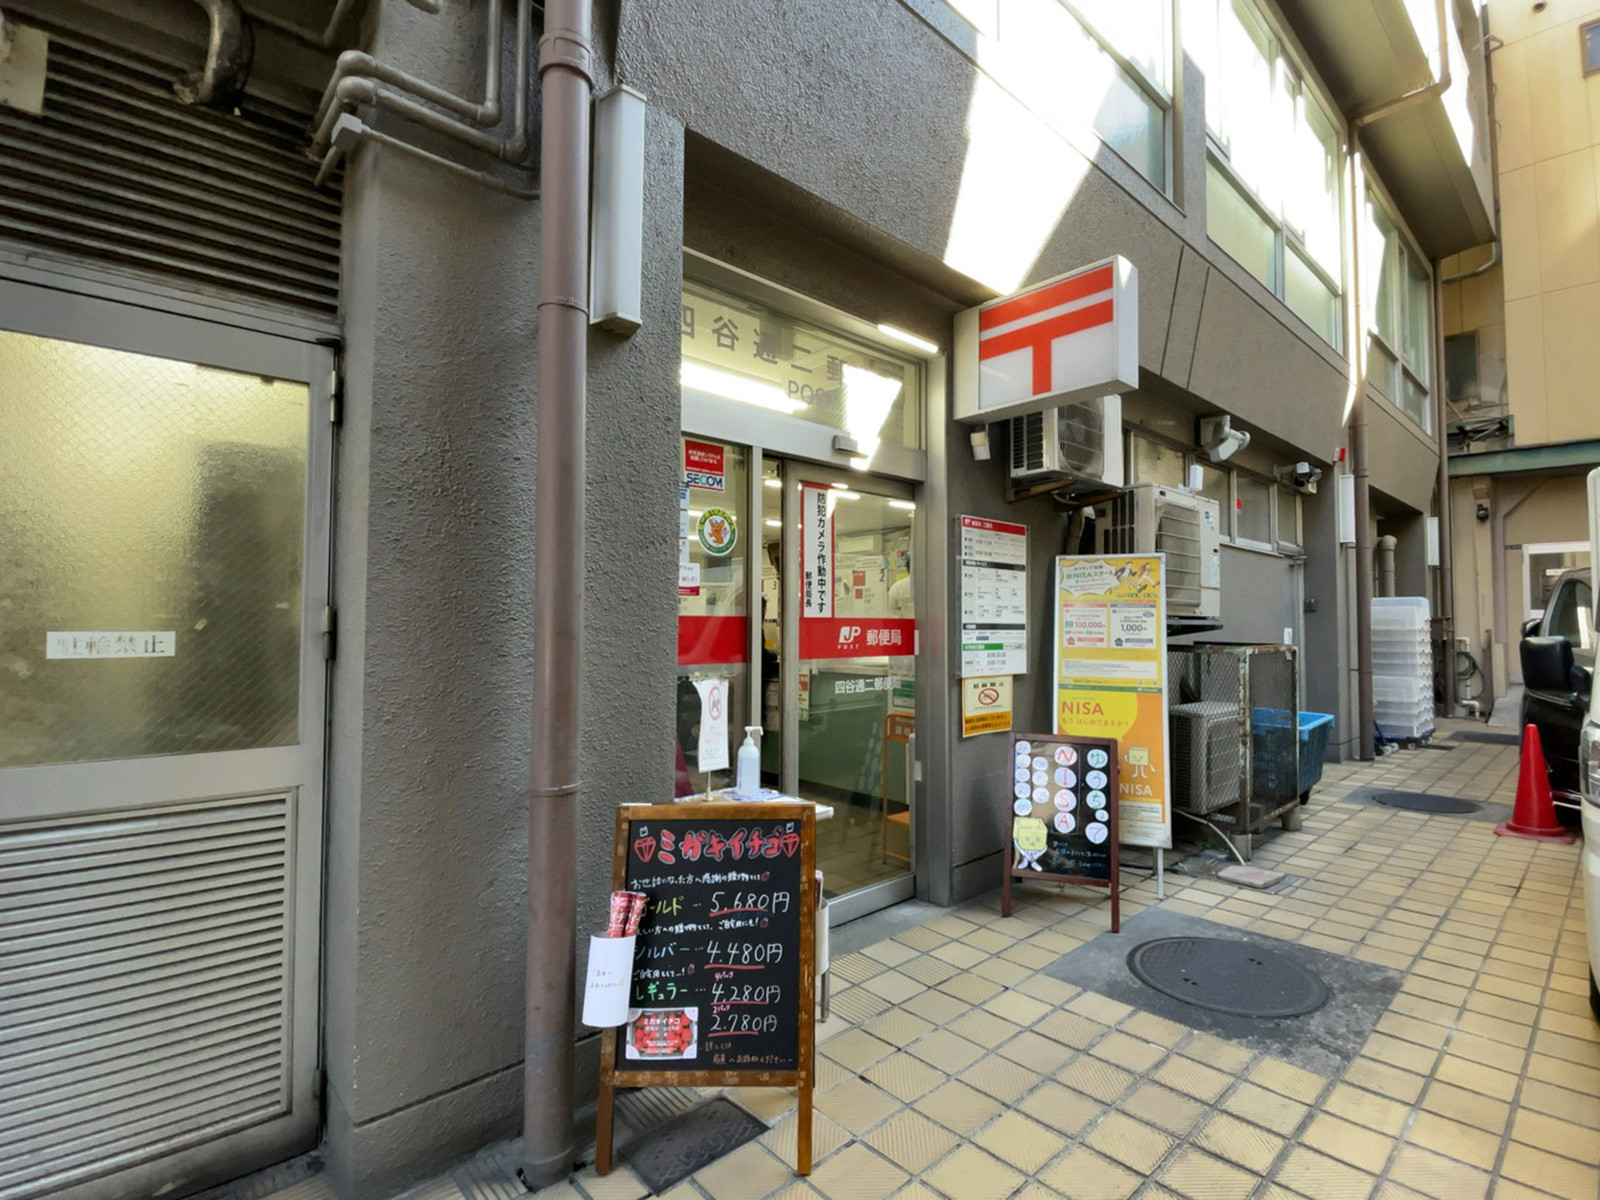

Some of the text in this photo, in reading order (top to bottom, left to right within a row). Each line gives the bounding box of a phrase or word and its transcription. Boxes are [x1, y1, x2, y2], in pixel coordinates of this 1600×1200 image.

[686, 473, 723, 488] SECOM
[816, 491, 828, 614] 防犯カメラ作動中です
[804, 571, 813, 608] 郵便局長
[866, 629, 902, 646] 郵便局
[1061, 700, 1104, 716] NISA
[1056, 748, 1076, 831] NISA
[1119, 782, 1153, 797] NISA
[657, 824, 783, 865] ミガキイチゴ
[635, 981, 688, 1002] レギュラー
